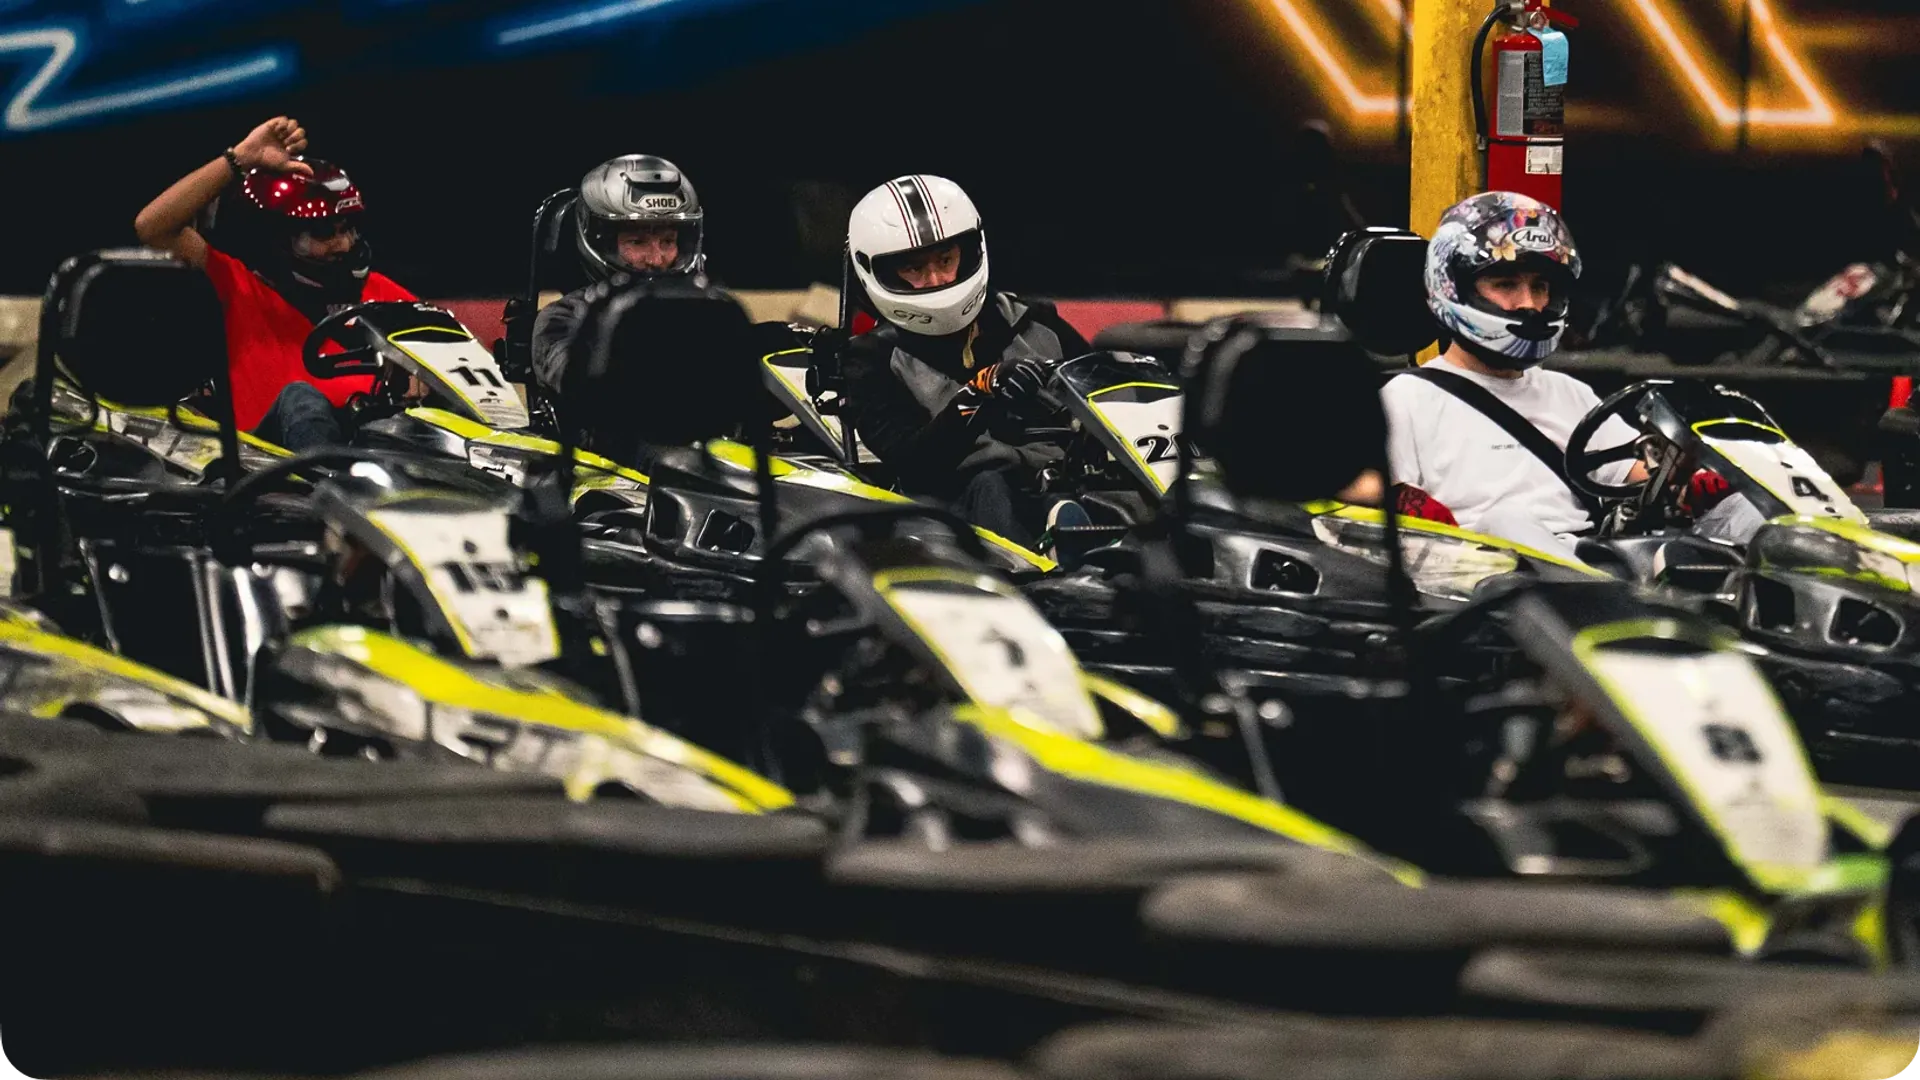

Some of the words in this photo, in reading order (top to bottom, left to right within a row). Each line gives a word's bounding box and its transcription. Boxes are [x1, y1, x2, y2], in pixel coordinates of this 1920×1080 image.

[645, 198, 678, 209] SHOEI
[1518, 229, 1552, 244] Arai
[893, 309, 932, 325] GT3
[447, 365, 503, 389] 11
[1134, 434, 1181, 465] 2
[1790, 476, 1830, 502] 4
